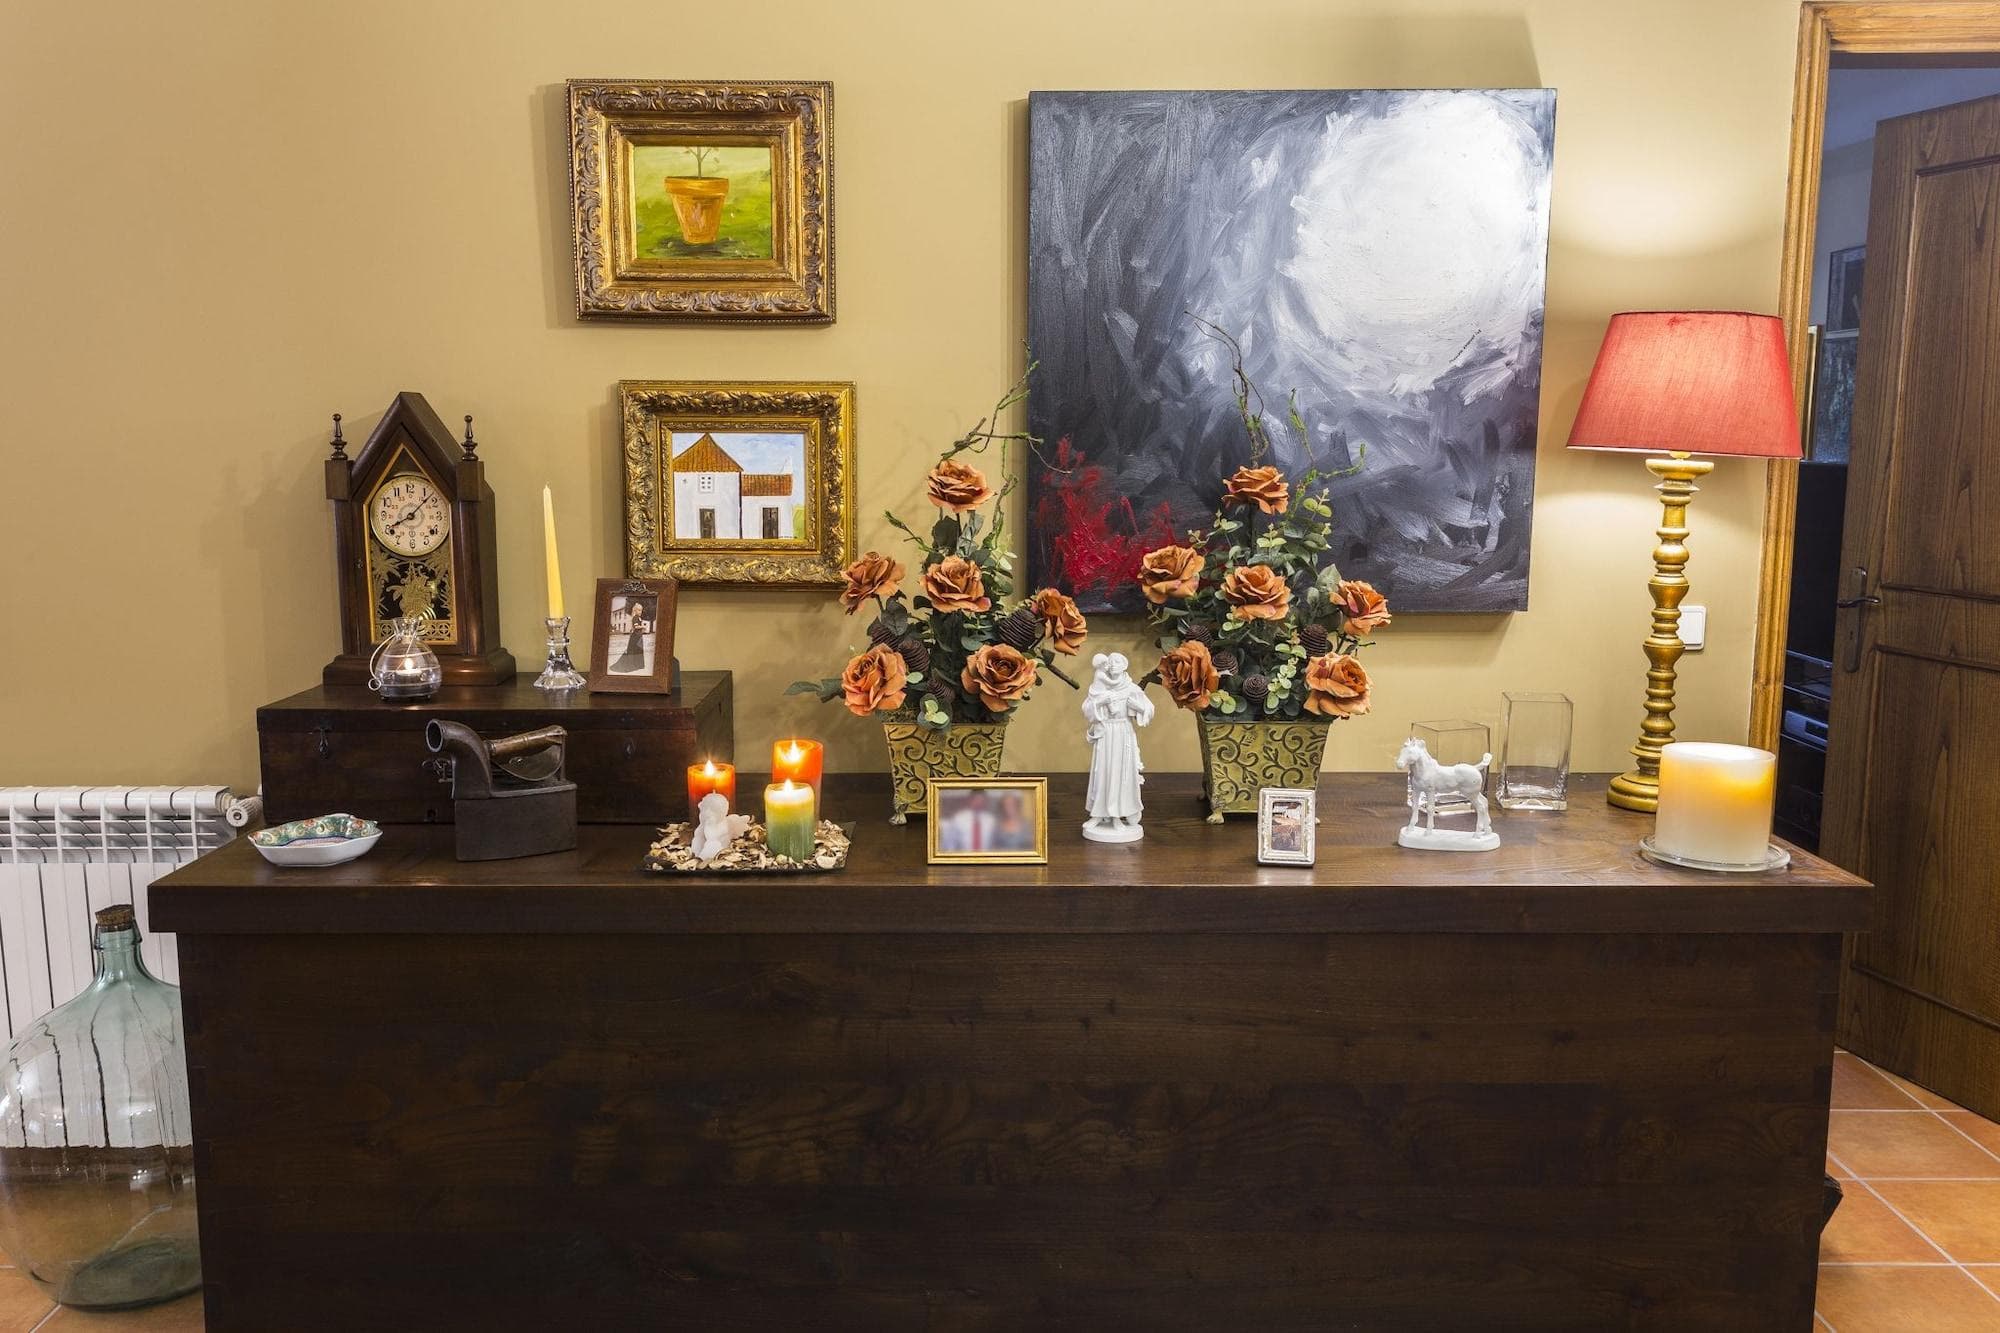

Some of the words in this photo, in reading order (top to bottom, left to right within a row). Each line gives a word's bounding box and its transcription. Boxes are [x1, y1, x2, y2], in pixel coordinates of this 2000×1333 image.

[393, 487, 400, 497] 11
[406, 483, 415, 493] 12
[383, 497, 391, 507] 10
[431, 497, 438, 507] 2
[381, 511, 387, 521] 9
[436, 511, 443, 521] 3
[395, 535, 401, 545] 7
[409, 538, 416, 549] 6
[423, 536, 430, 545] 5
